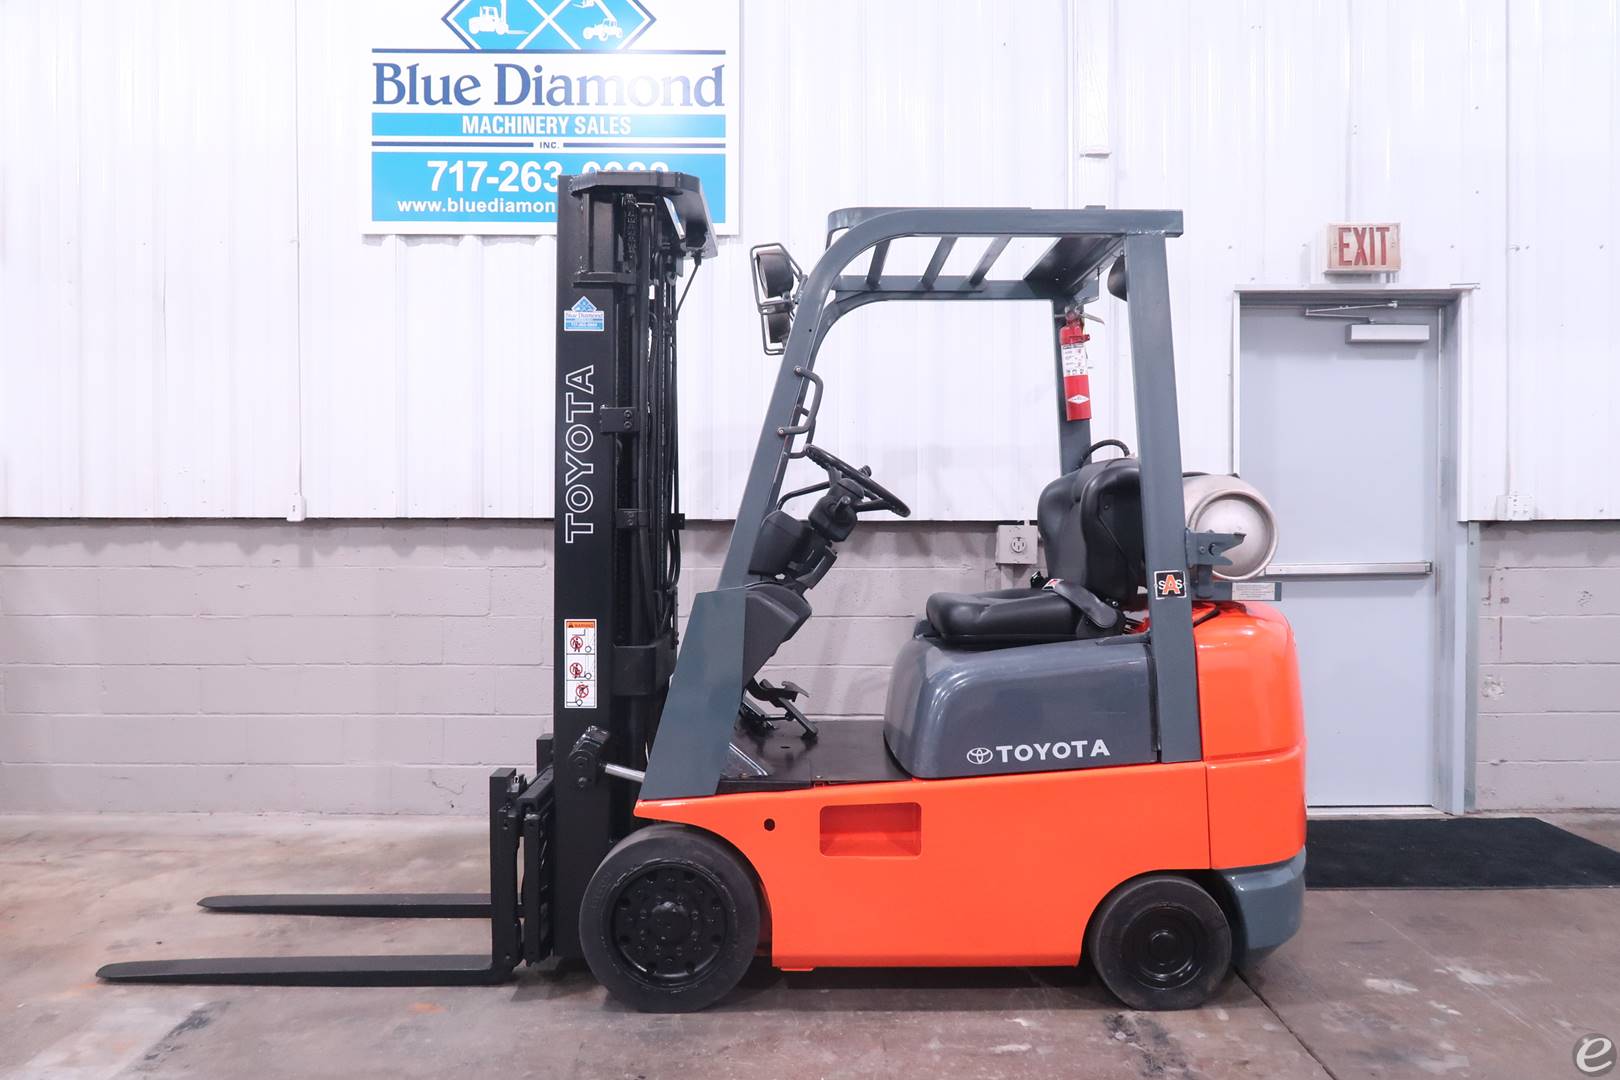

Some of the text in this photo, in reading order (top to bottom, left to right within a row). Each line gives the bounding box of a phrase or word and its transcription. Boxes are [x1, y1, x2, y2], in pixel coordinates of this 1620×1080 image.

[372, 62, 725, 107] Blue Diamond
[462, 115, 632, 135] MACHINERY SALES
[539, 141, 560, 149] INC.
[397, 197, 557, 214] www.bluediamon
[1338, 226, 1390, 266] EXIT
[565, 365, 594, 544] TOYOTA
[996, 739, 1111, 763] TOYOTA
